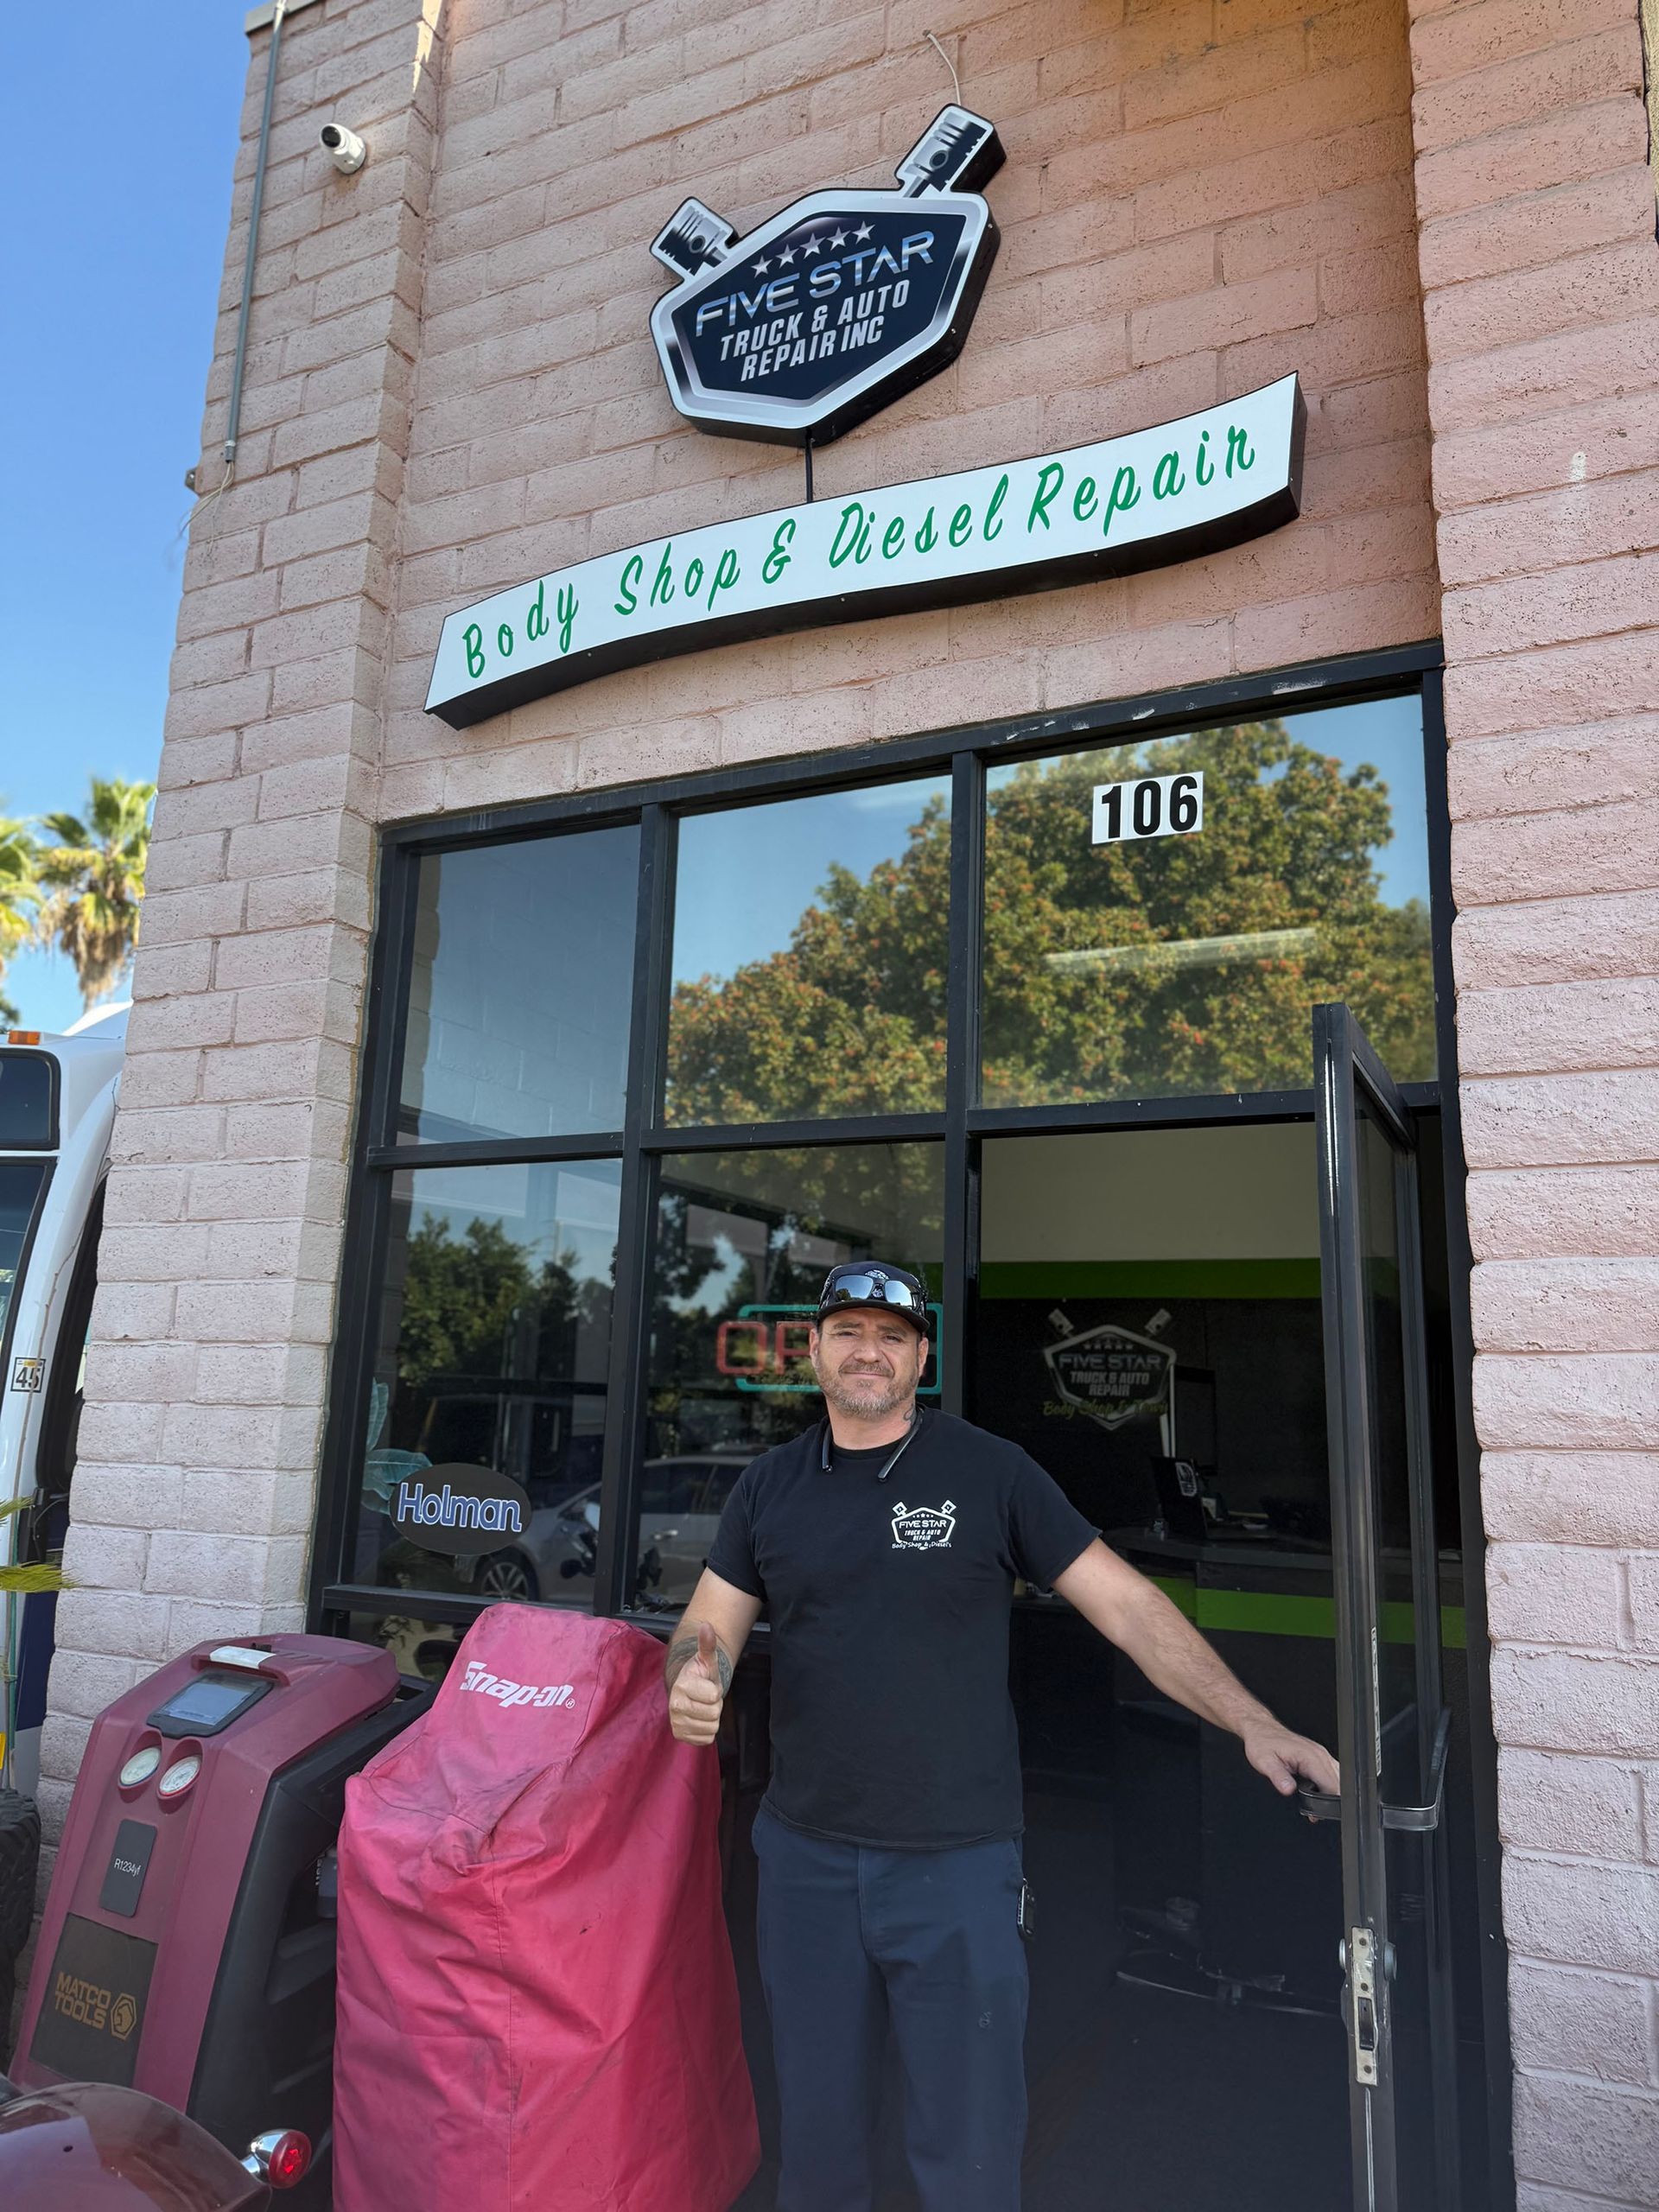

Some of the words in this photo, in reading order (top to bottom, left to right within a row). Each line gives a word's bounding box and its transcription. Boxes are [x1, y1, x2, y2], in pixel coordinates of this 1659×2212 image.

[696, 272, 800, 337] FIVE
[809, 231, 935, 300] STAR
[720, 311, 804, 361] TRUCK
[811, 304, 829, 331] &
[838, 279, 910, 324] AUTO
[741, 330, 836, 382] REPAIR
[840, 315, 885, 353] INC
[461, 580, 579, 678] Body
[614, 542, 741, 612] Shop
[762, 518, 796, 584] &
[829, 474, 1010, 569] Diesel
[1027, 425, 1255, 536] Repair
[1100, 774, 1198, 839] 106
[1058, 1353, 1105, 1370] FIVE
[1108, 1354, 1161, 1370] STAR
[1070, 1370, 1107, 1385] TRUCK
[1119, 1372, 1150, 1385] AUTO
[1089, 1384, 1130, 1396] REPAIR
[397, 1482, 523, 1532] Holman
[899, 1520, 920, 1529] FIVE
[922, 1519, 947, 1528] STAR
[54, 1990, 108, 2030] TOOLS
[56, 1970, 111, 2010] MATCO
